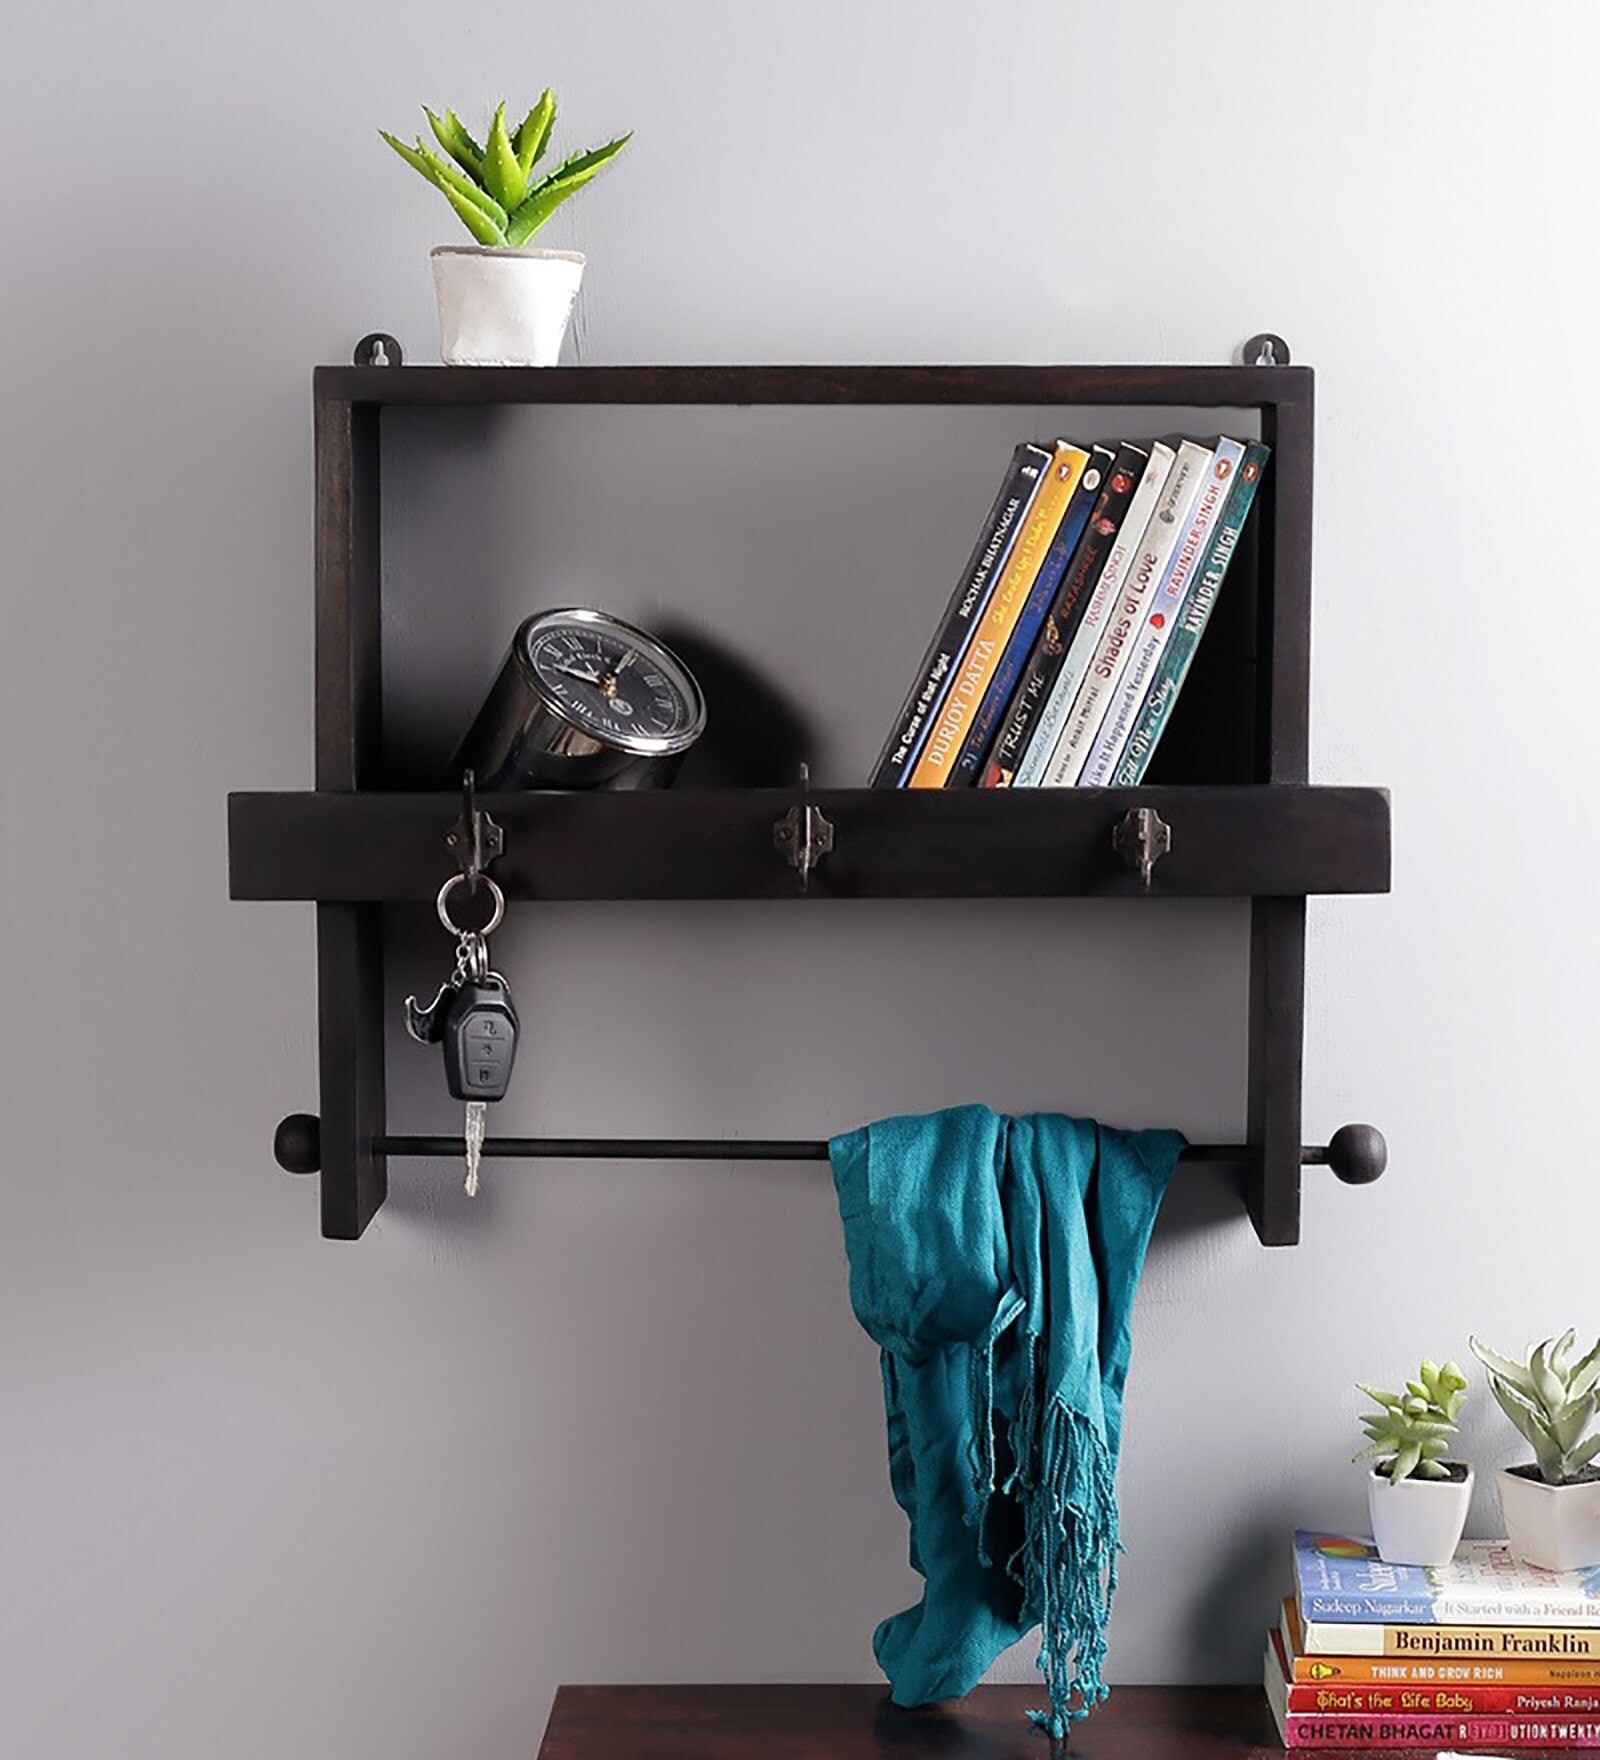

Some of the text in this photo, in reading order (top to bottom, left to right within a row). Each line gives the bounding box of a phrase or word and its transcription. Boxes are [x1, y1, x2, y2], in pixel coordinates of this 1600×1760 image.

[959, 497, 1018, 616] ROCHAK BHATNAGAR
[1165, 529, 1201, 594] RAVINDER
[1191, 483, 1221, 528] SINGH
[1208, 524, 1240, 568] SINGH
[1094, 551, 1159, 677] Shades of Love
[1127, 634, 1159, 691] Yesterday
[890, 651, 953, 765] The Curse of that Night
[928, 637, 994, 765] DURJOY DATTA
[997, 696, 1035, 759] TRUST
[1025, 671, 1046, 697] ME
[1103, 693, 1138, 752] Happened
[1116, 673, 1178, 787] Tell Me a Story
[1098, 750, 1111, 761] It
[1313, 1598, 1425, 1616] Sudeep Nagarkar
[1445, 1602, 1454, 1614] It
[1457, 1602, 1502, 1615] Started
[1504, 1602, 1531, 1616] with
[1533, 1606, 1541, 1616] a
[1544, 1603, 1583, 1616] Friend
[1396, 1631, 1590, 1654] Benjamin Franklin
[1371, 1666, 1408, 1679] THINK
[1411, 1666, 1435, 1679] AND
[1473, 1667, 1503, 1680] RICH
[1317, 1690, 1473, 1712] That's the Life Baby
[1517, 1695, 1560, 1711] Priyesh
[1298, 1724, 1374, 1739] CHETAN
[1380, 1724, 1455, 1739] BHAGAT
